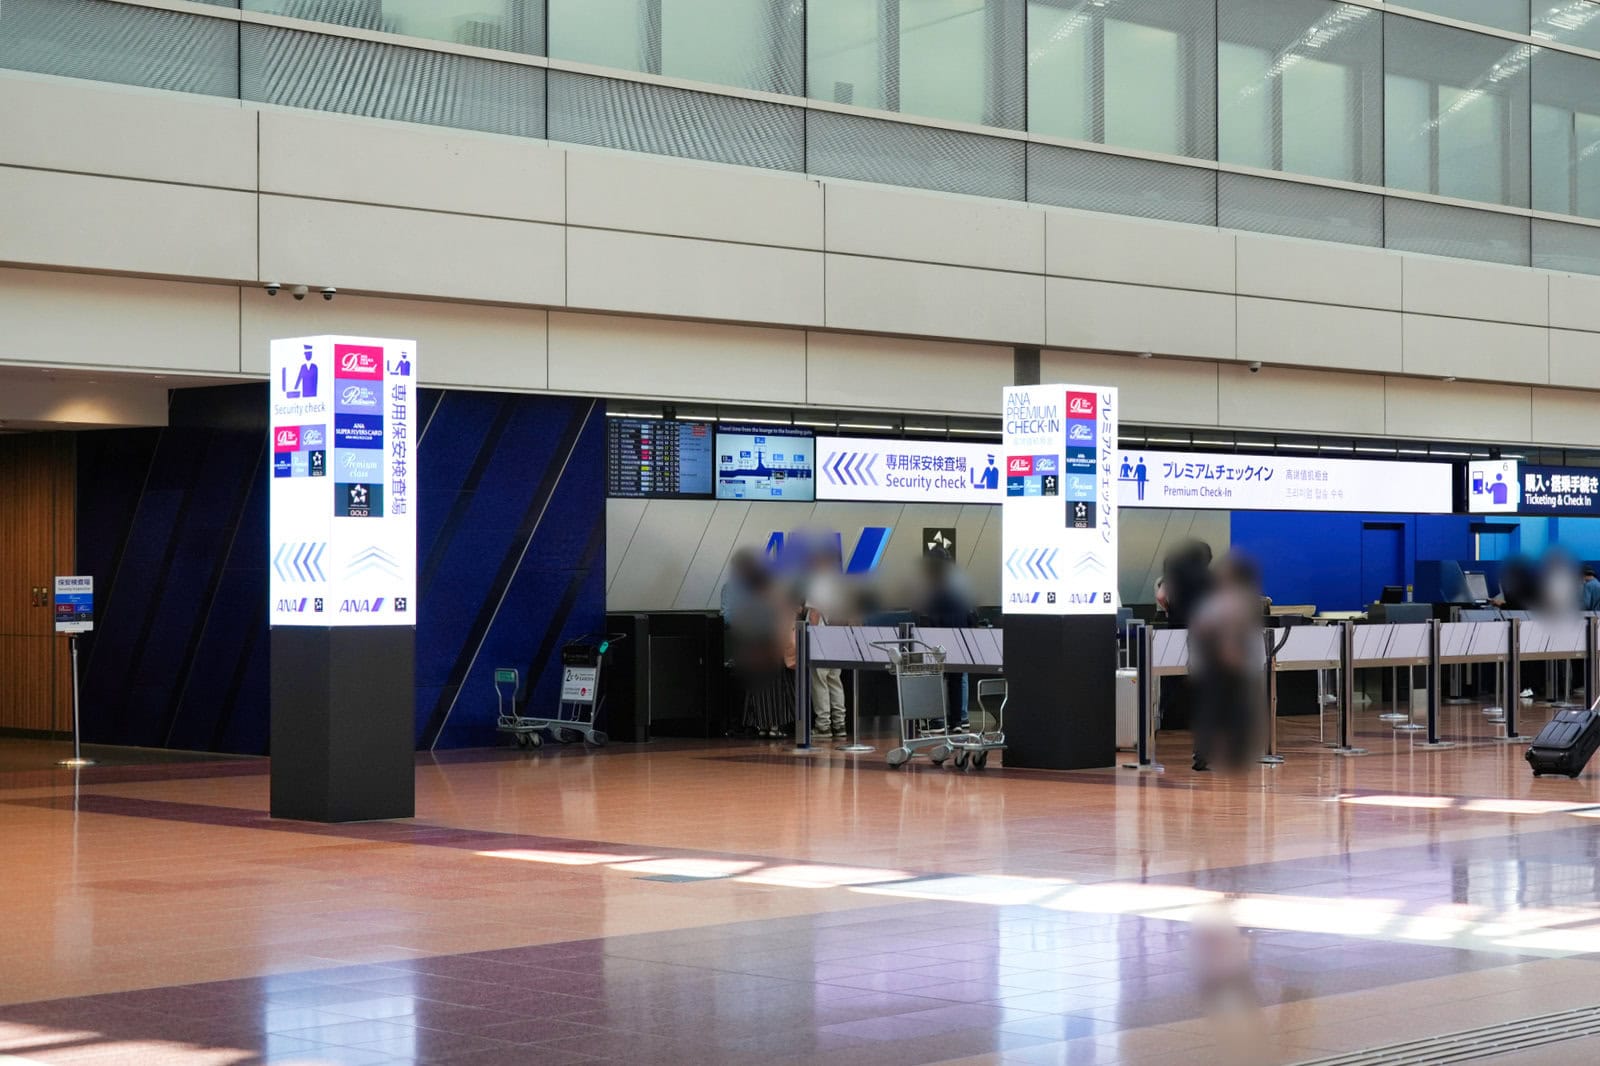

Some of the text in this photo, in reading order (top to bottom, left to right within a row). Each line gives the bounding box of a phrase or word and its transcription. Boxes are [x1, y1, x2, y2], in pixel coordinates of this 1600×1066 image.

[1008, 392, 1030, 406] ANA
[274, 402, 326, 416] Security check
[1007, 405, 1057, 420] PREMIUM
[1006, 419, 1060, 435] CHECK-IN
[391, 384, 407, 515] 専用保安検査場
[886, 454, 967, 472] 専用保安検査場
[1101, 393, 1112, 545] プレミアムチェックイン
[1163, 462, 1274, 481] プレミアムチェックイン
[886, 474, 967, 491] Security check
[1164, 485, 1232, 497] Premium Check-In
[1525, 494, 1592, 508] Ticketing & Check In
[276, 599, 297, 613] ANA
[339, 599, 370, 613] ANA
